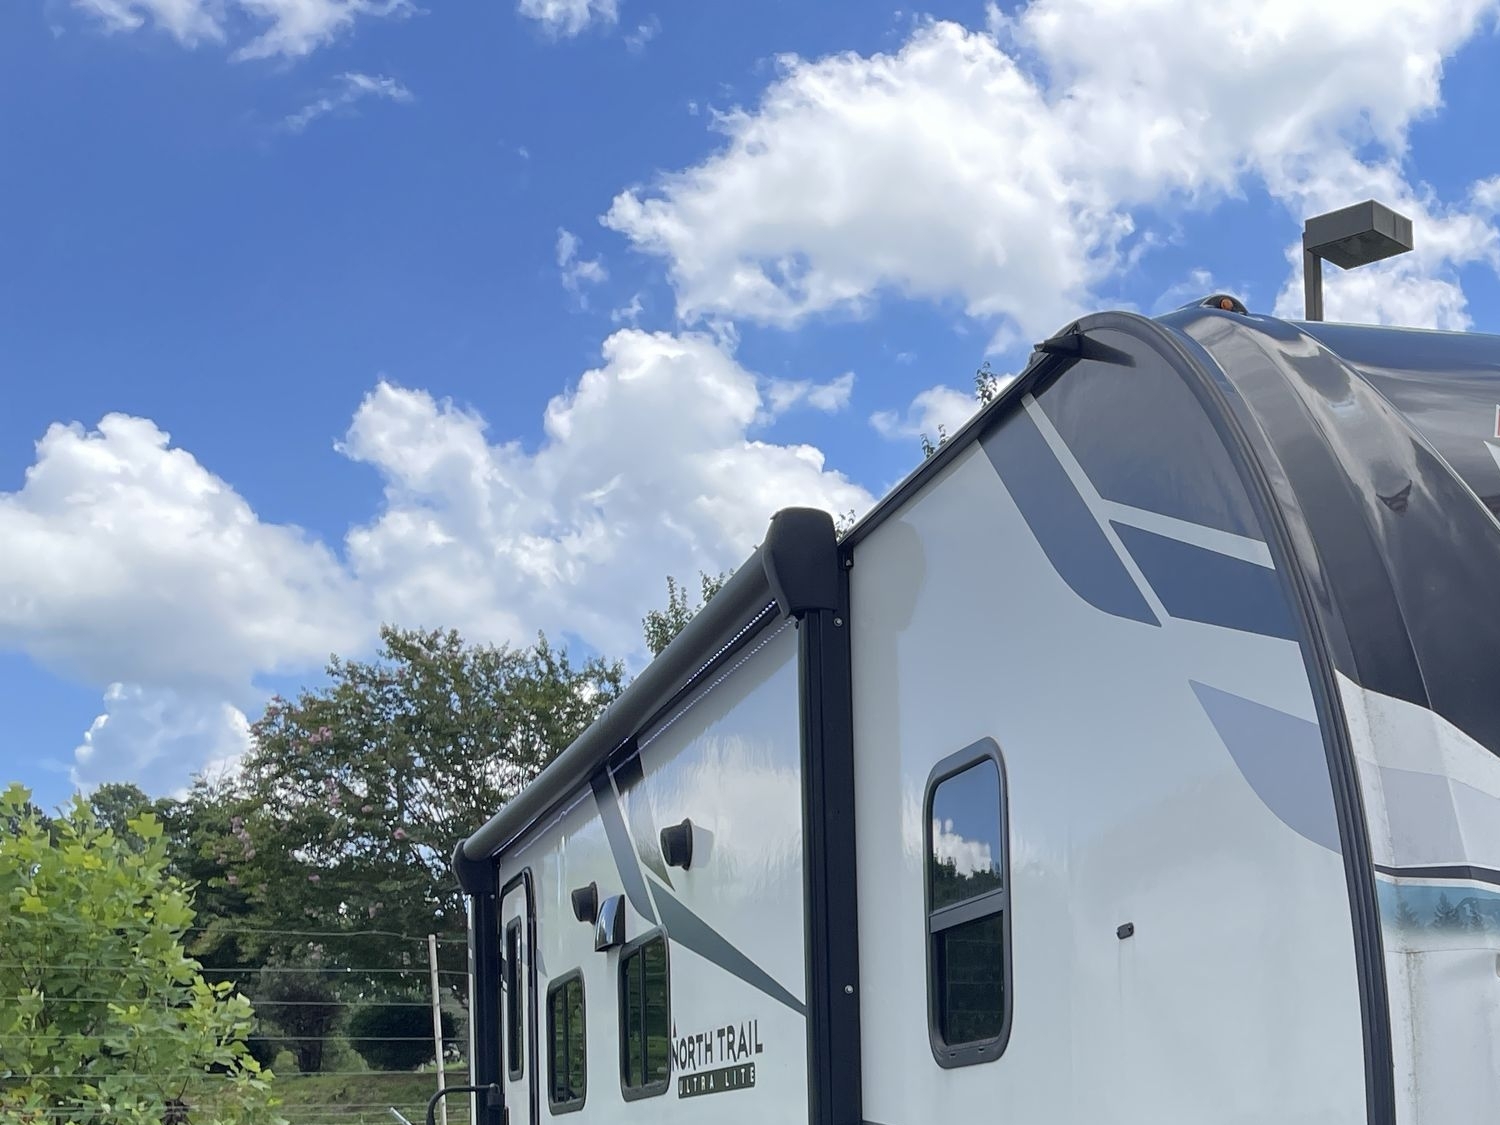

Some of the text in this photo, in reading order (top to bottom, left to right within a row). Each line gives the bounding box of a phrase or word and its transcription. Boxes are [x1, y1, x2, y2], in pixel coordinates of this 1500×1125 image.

[671, 1019, 763, 1072] NORTH TRAIL
[679, 1065, 755, 1095] ULTRA LITE
